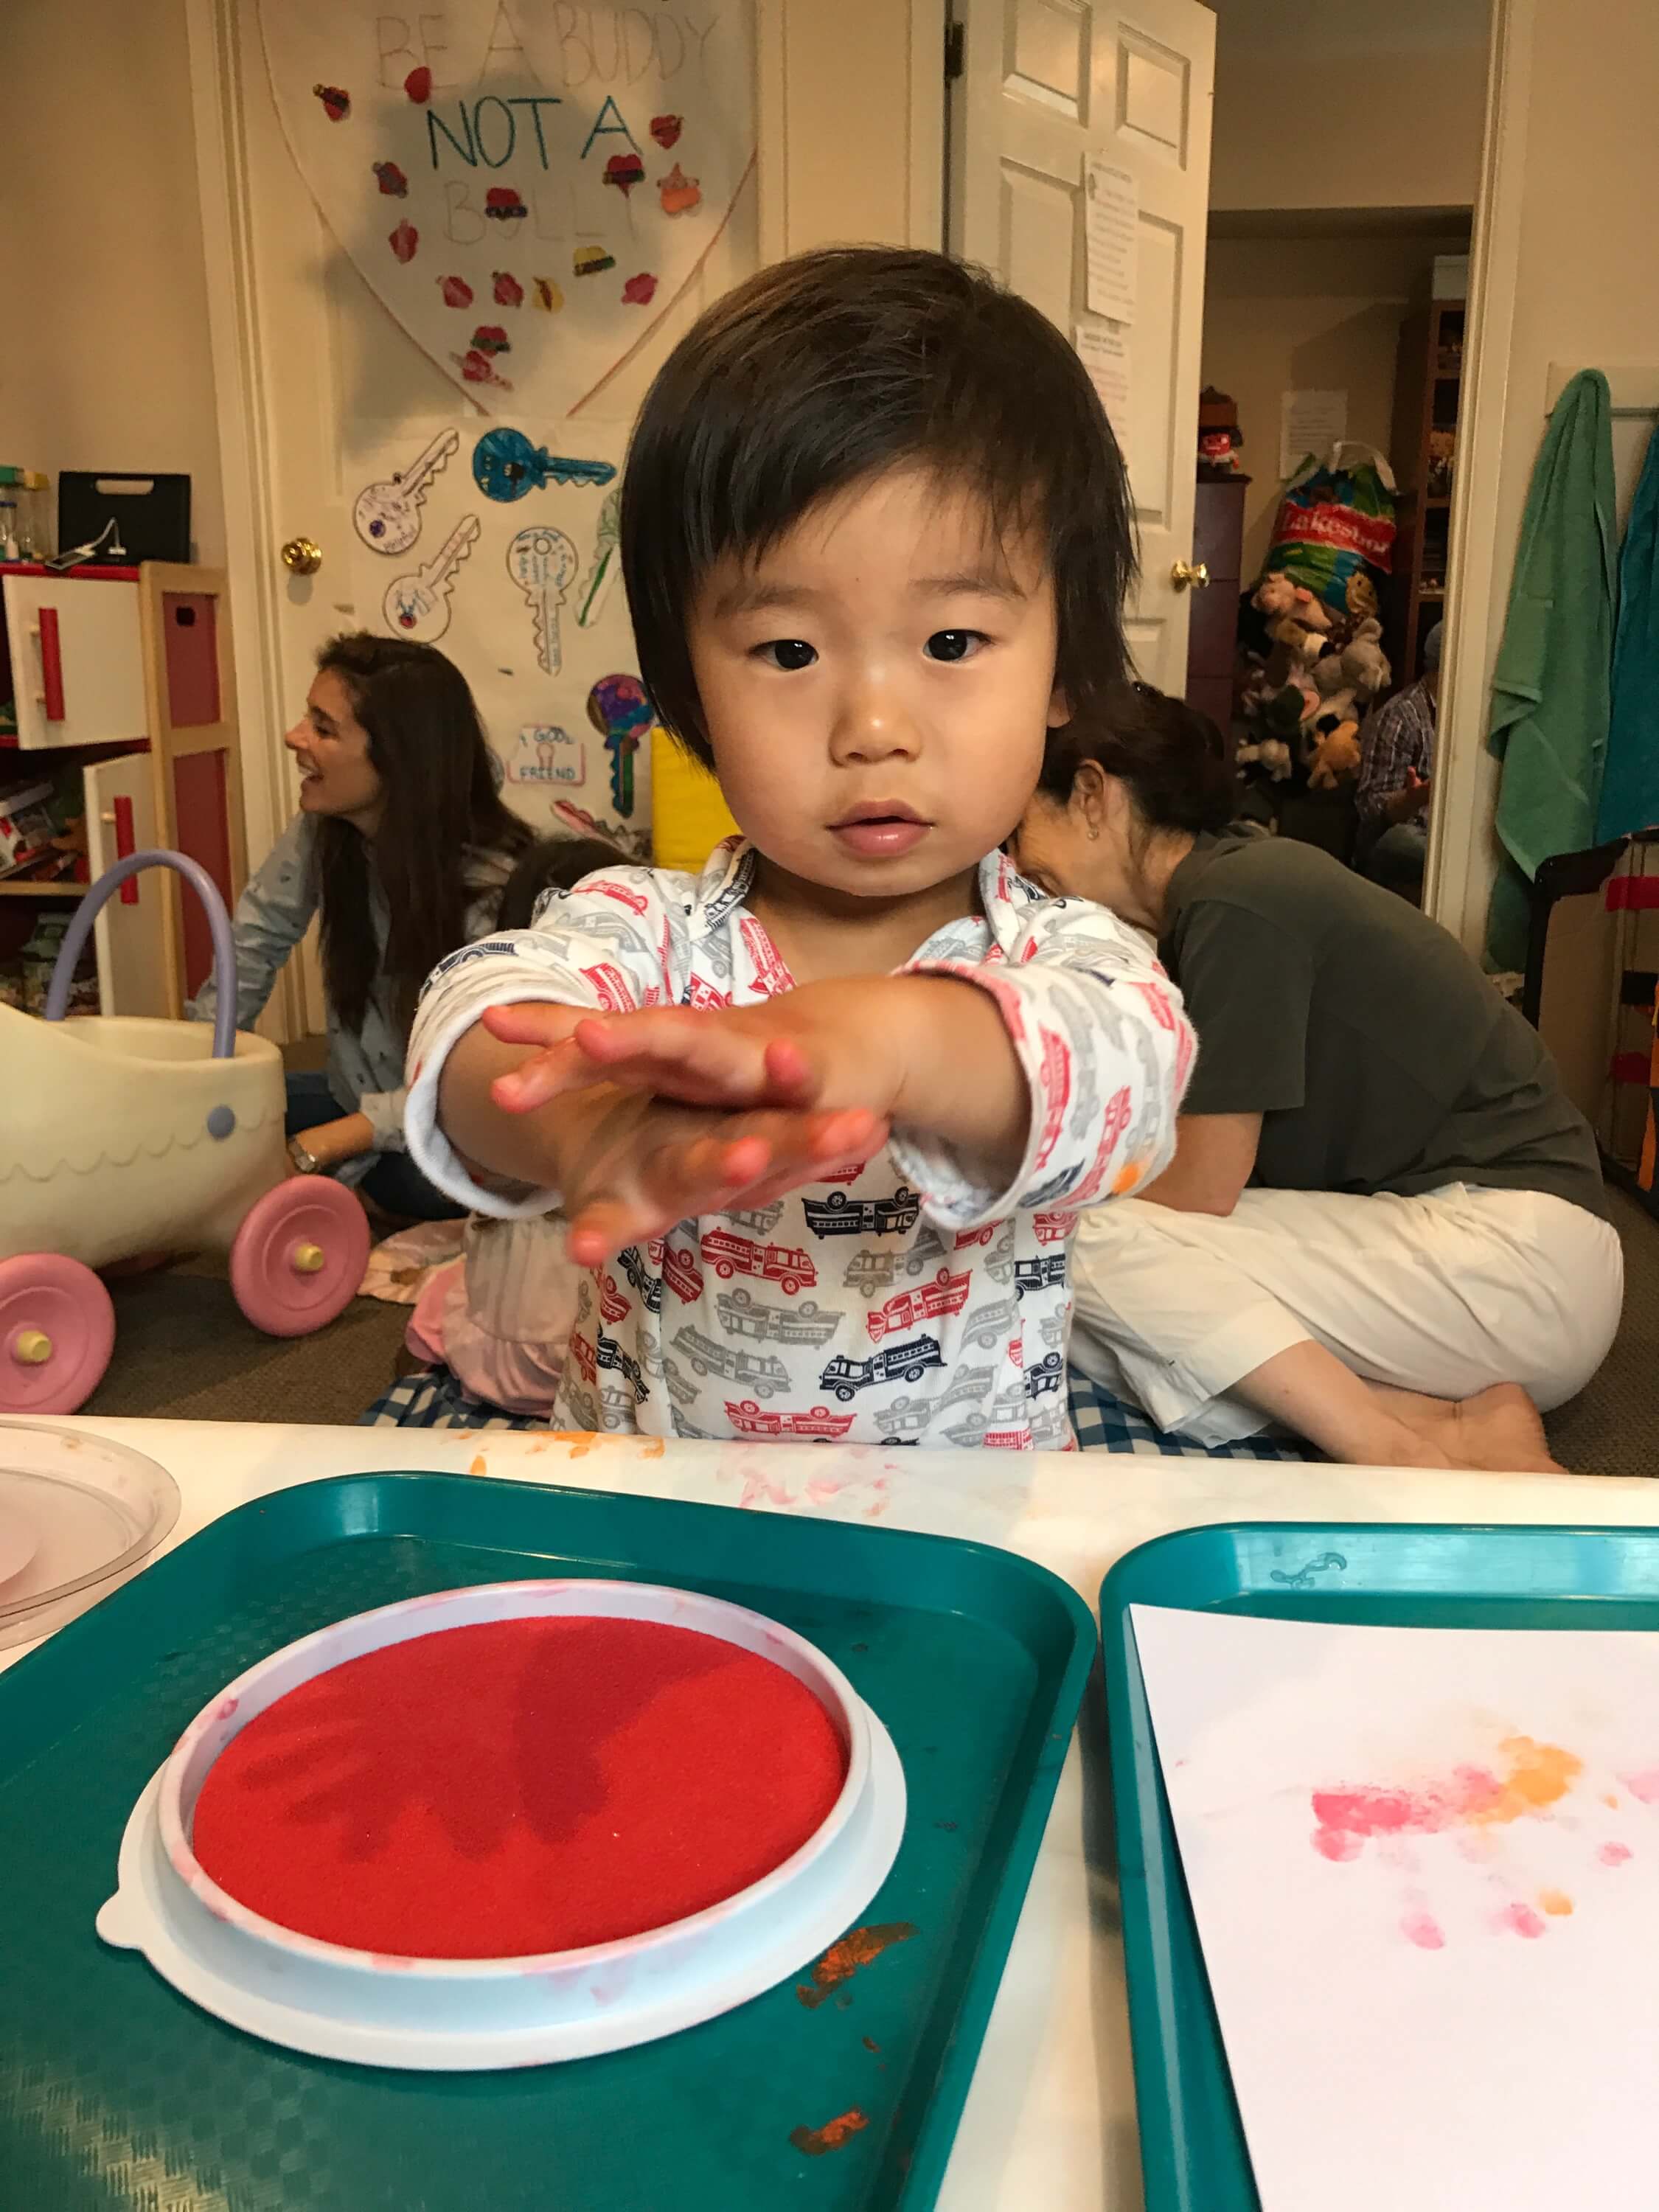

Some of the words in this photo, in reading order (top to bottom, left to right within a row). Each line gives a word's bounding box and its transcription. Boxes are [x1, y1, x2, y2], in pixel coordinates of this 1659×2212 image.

[376, 14, 459, 89] BE
[478, 0, 543, 88] A
[553, 0, 720, 88] BUDDY
[427, 95, 562, 170] NOT
[580, 95, 643, 160] A
[520, 766, 575, 780] FRIEND
